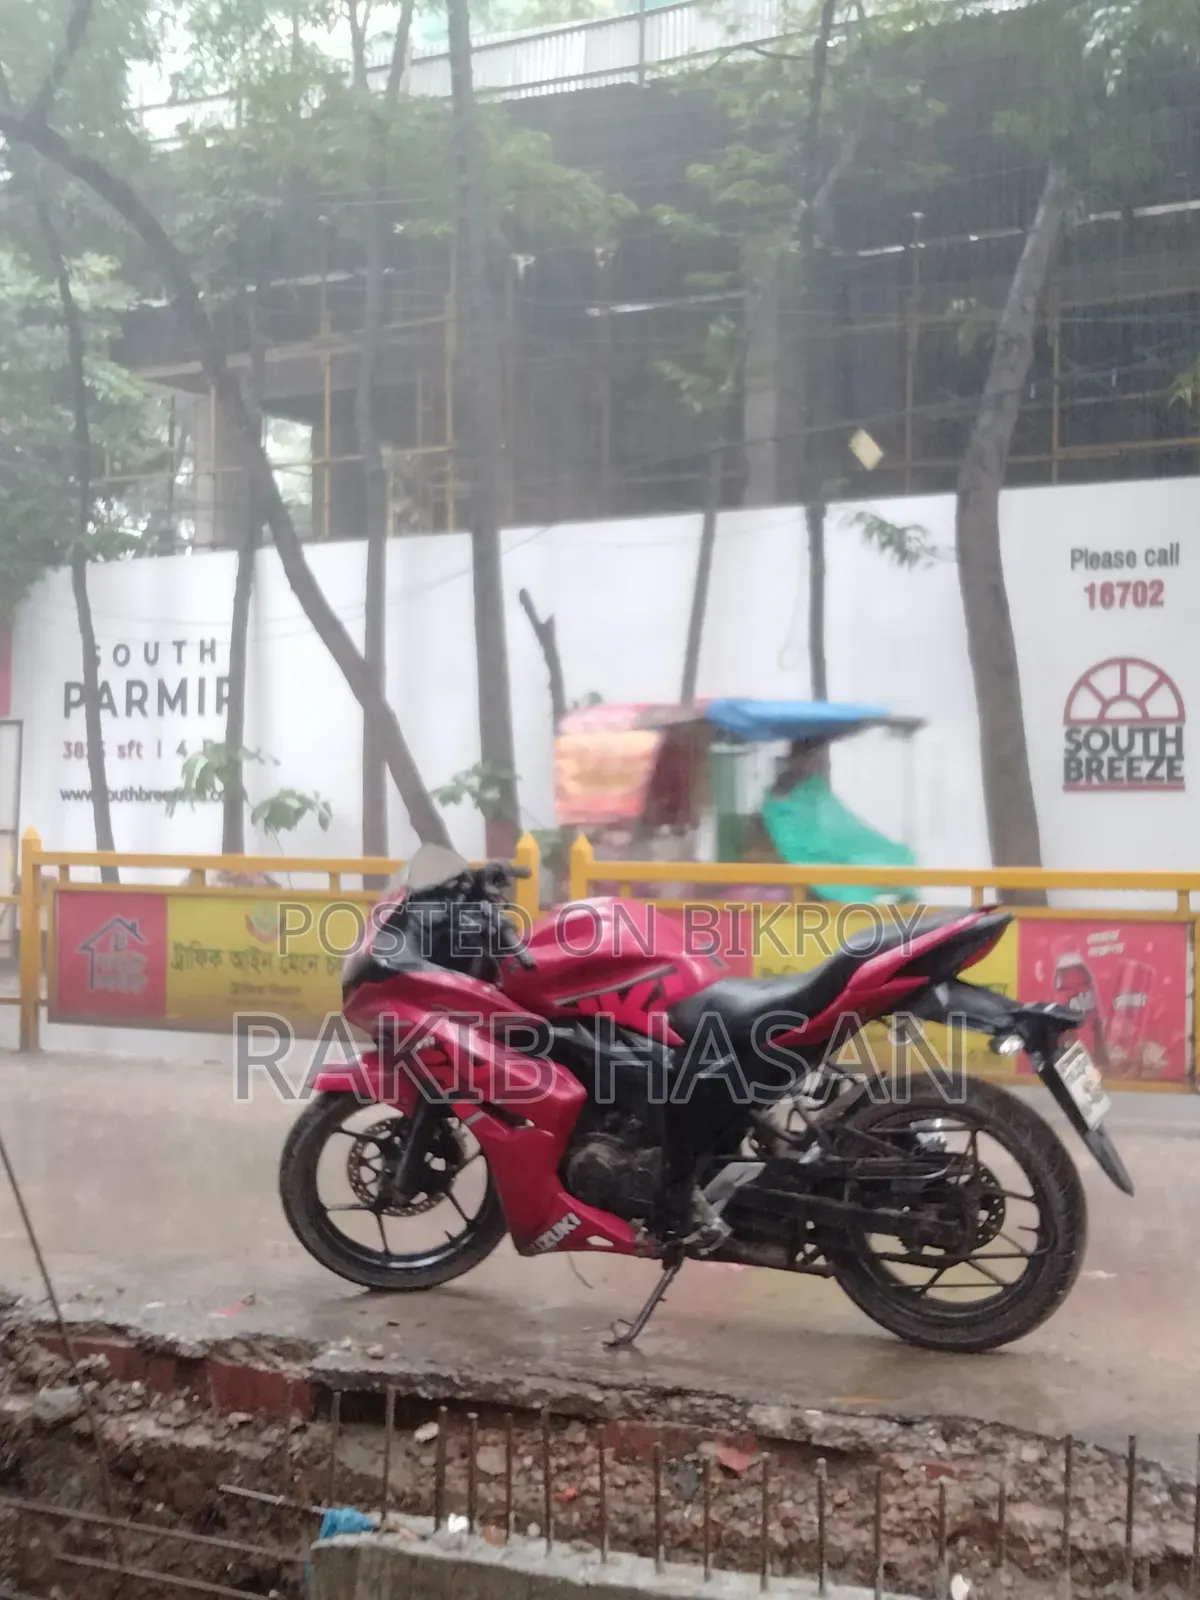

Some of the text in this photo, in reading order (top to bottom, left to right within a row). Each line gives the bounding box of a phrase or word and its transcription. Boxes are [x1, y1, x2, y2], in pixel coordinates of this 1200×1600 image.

[1070, 543, 1180, 570] Please call
[1084, 579, 1164, 610] 16702
[1064, 725, 1184, 757] SOUTH
[1064, 755, 1185, 783] BREEZE
